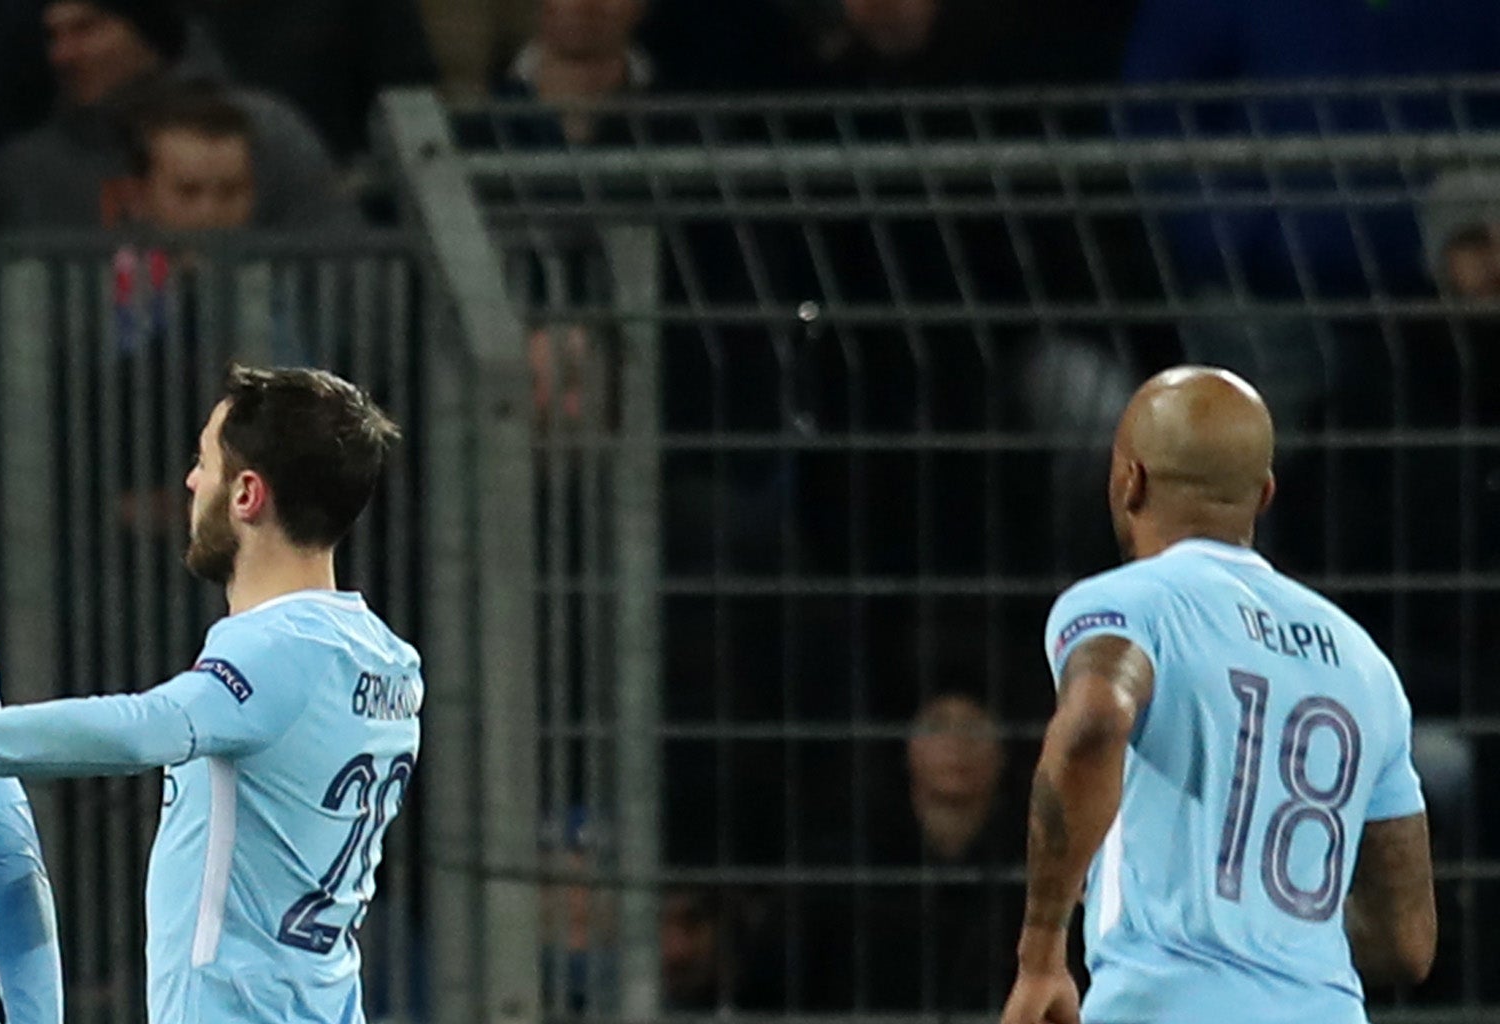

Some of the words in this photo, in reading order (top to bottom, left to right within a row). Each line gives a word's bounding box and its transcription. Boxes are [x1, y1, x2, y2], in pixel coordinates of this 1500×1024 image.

[1238, 602, 1341, 667] DELPH
[277, 753, 414, 955] 20
[1216, 668, 1362, 922] 18
